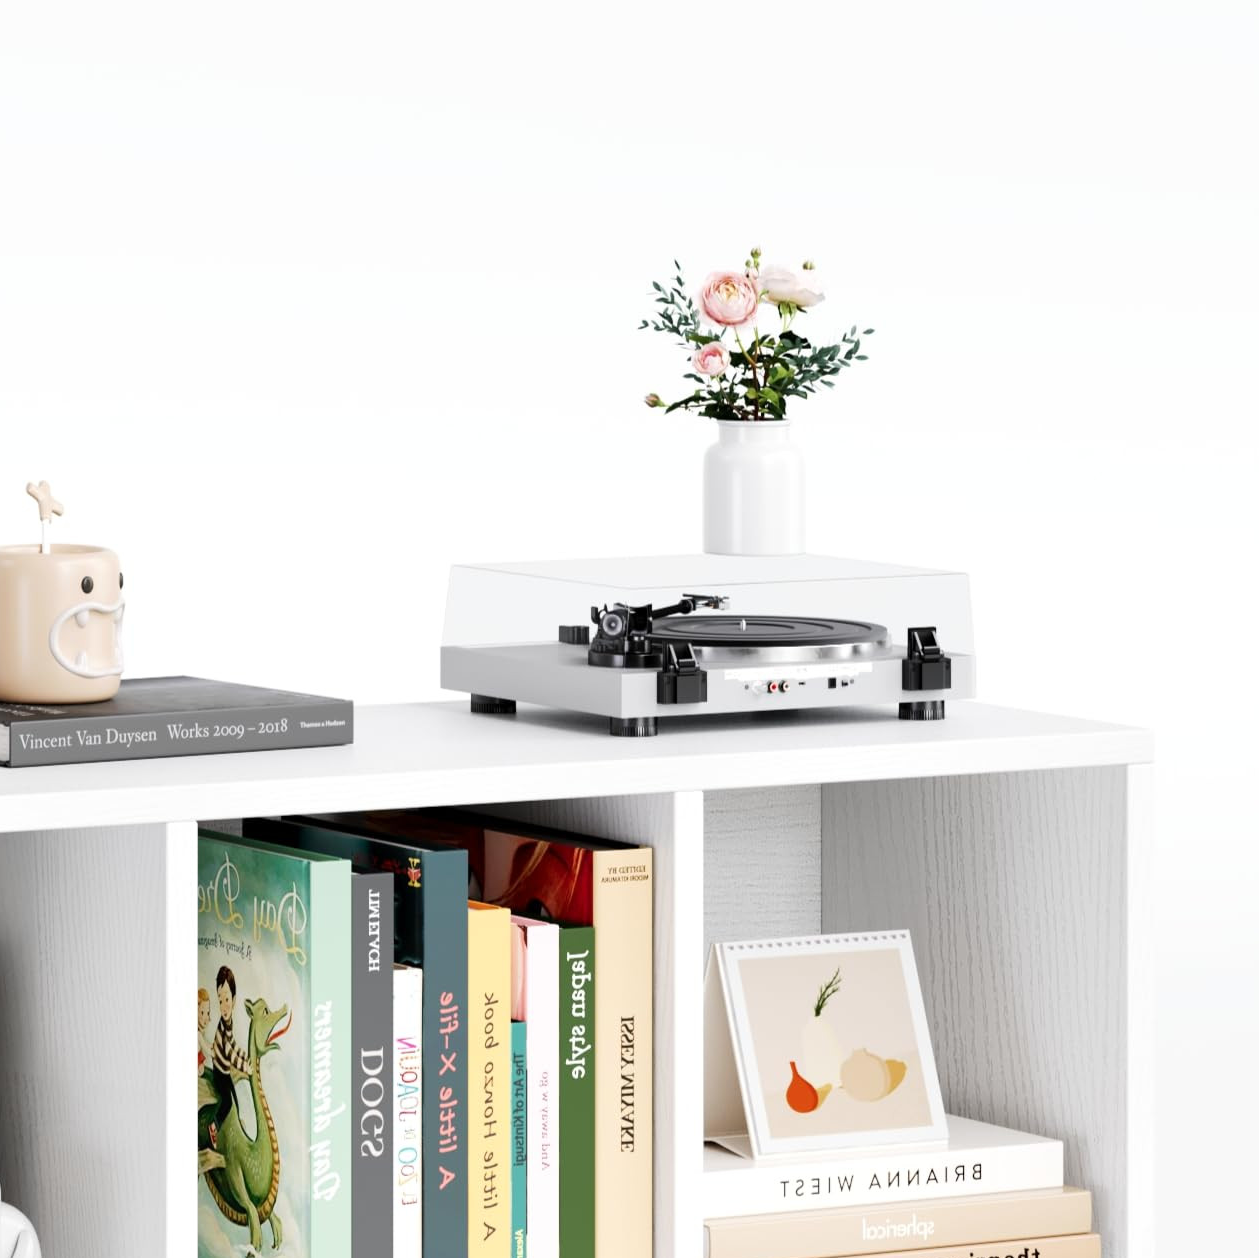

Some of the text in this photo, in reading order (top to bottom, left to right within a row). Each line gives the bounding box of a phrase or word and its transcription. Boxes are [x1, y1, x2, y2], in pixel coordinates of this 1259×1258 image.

[19, 733, 73, 750] Vincent
[75, 729, 102, 747] Van
[105, 728, 157, 748] Duysen
[167, 722, 210, 740] Works
[213, 724, 245, 740] 2009
[258, 718, 288, 734] 2018
